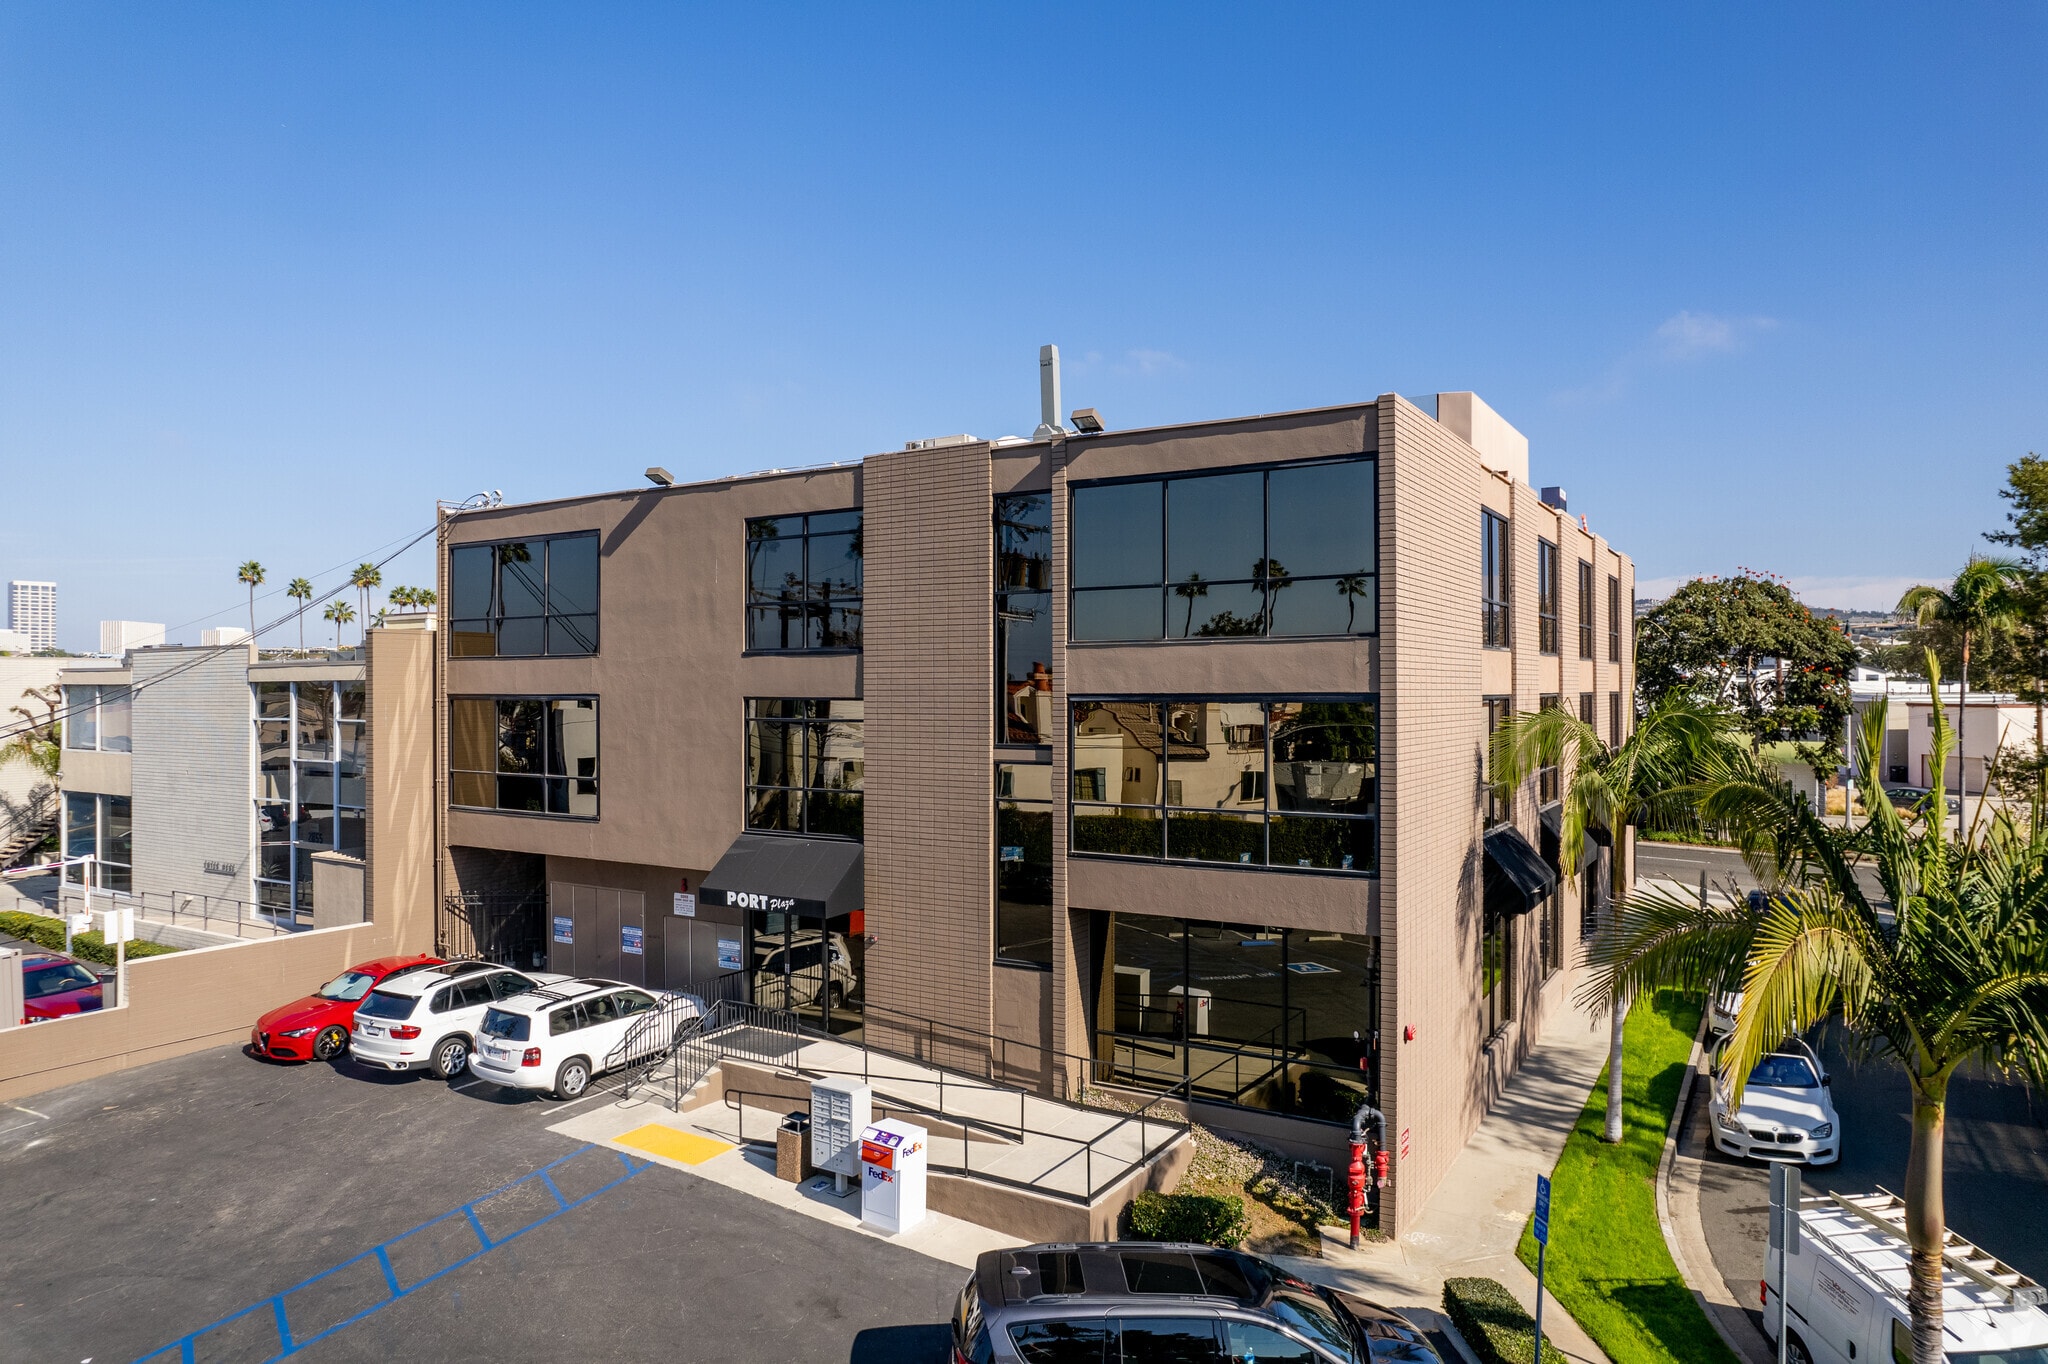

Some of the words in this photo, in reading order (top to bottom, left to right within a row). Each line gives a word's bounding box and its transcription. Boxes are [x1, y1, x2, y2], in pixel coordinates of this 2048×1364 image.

[727, 891, 768, 910] PORT
[769, 898, 795, 911] Plaza
[902, 1142, 922, 1158] FedEx
[868, 1166, 893, 1183] FedEx
